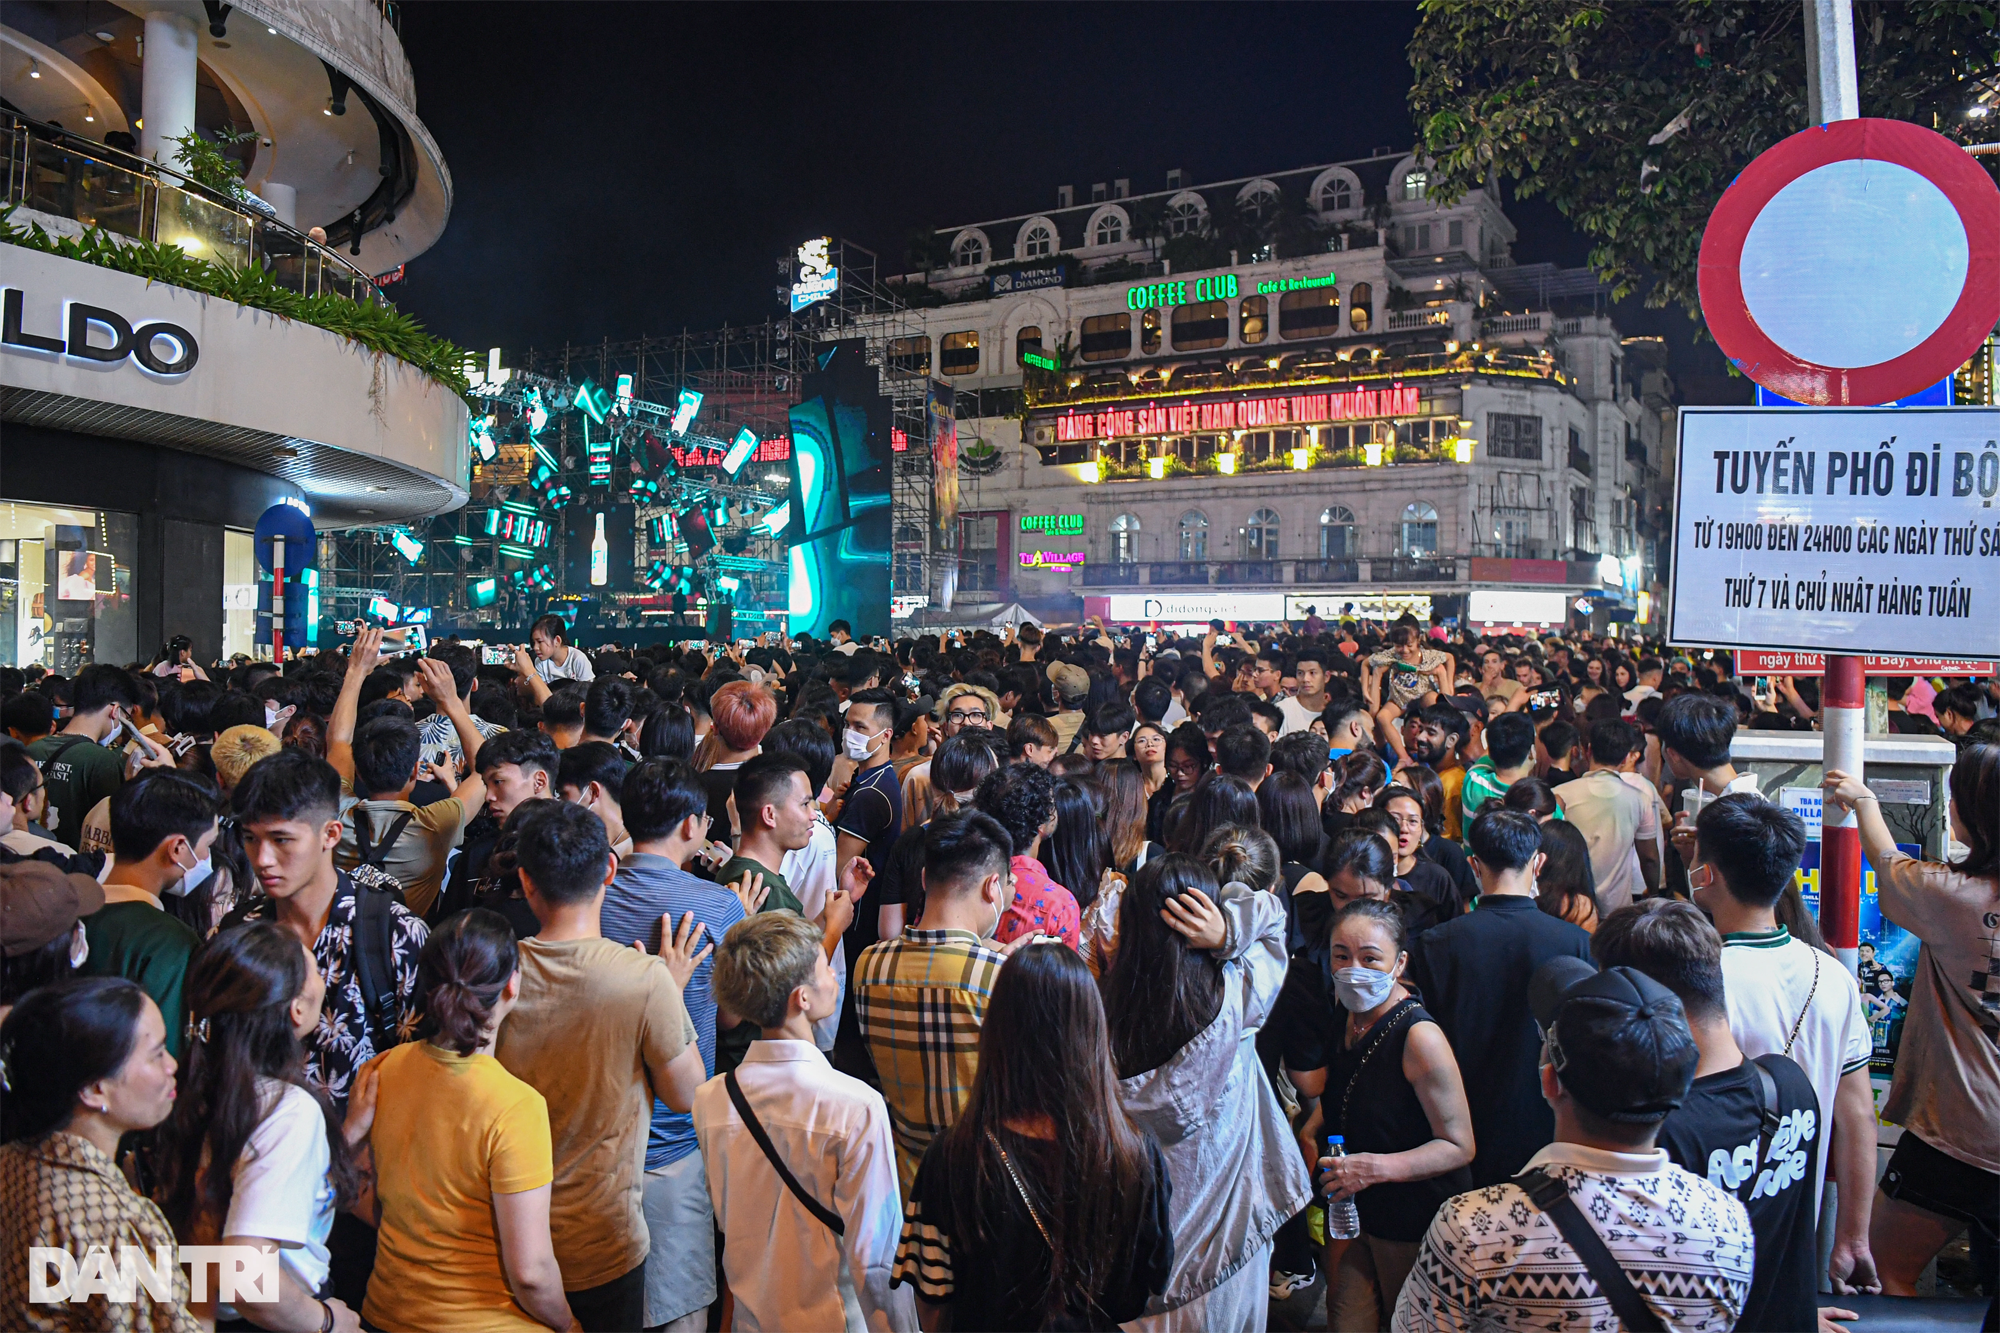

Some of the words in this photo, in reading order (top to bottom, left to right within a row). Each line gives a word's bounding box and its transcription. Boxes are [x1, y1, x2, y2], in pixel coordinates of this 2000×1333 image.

[1016, 276, 1062, 289] DIAMOND
[1021, 267, 1056, 280] MINH
[1257, 281, 1279, 295] Café
[1288, 272, 1336, 291] Restaurant
[1127, 281, 1187, 310] COFFEE
[1195, 273, 1239, 302] CLUB
[930, 399, 956, 420] CHILL
[1057, 408, 1094, 441] ĐẢNG
[1097, 406, 1134, 441] CỘNG
[1138, 401, 1167, 434] SẢN
[1169, 400, 1199, 436] VIỆT
[1201, 402, 1236, 430] NAM
[1237, 397, 1288, 430] QUANG
[1291, 394, 1328, 422] VINH
[1330, 384, 1378, 420] MUÔN
[1380, 382, 1418, 416] NĂM
[1713, 437, 1815, 494] TUYẾN
[1826, 436, 1897, 496] PHỐ
[1952, 440, 1999, 507] BỘ
[1021, 515, 1056, 530] COFFEE
[1058, 514, 1083, 529] CLUB
[1694, 516, 1714, 549] TỪ
[1767, 514, 1799, 551] ĐẾN
[1857, 520, 1889, 554] CÁC
[1894, 520, 1938, 555] NGÀY
[1944, 520, 1978, 556] THỨ
[1725, 572, 1755, 608] THỨ
[1758, 580, 1766, 608] 7
[1772, 574, 1790, 609] VÀ
[1796, 570, 1827, 611] CHỦ
[1877, 577, 1922, 616] HÀNG
[1928, 577, 1971, 618] TUẦN
[1759, 652, 1791, 669] ngày
[1800, 797, 1812, 805] TBA
